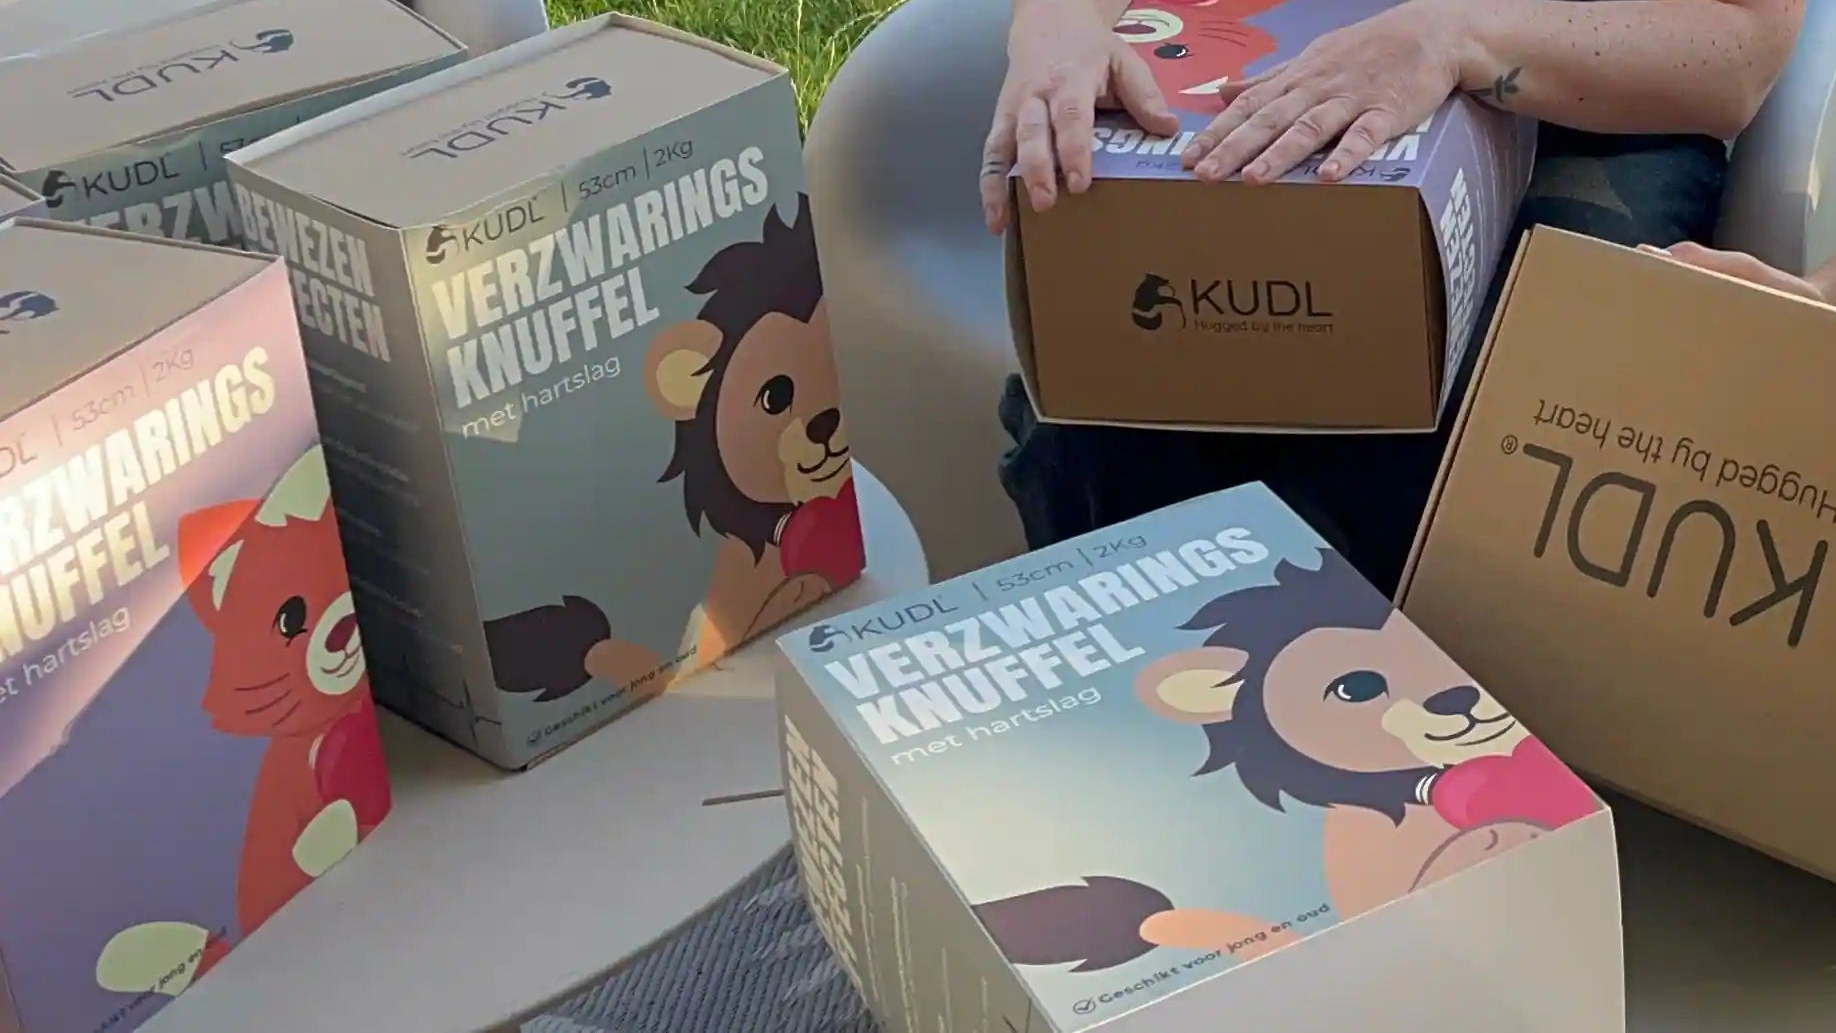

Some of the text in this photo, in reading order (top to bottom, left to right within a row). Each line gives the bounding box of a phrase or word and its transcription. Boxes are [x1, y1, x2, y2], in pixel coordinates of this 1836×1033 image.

[73, 50, 238, 101] KUDL
[409, 100, 566, 159] KUDL
[82, 155, 181, 199] KUDL
[463, 199, 545, 251] KUDL
[579, 166, 636, 200] 53cm
[236, 183, 374, 297] BEWEZEN
[431, 148, 768, 339] VERZWARINGS
[293, 269, 391, 363] ECTEN
[447, 267, 659, 409] KNUFFEL
[1190, 279, 1333, 317] KUDL
[0, 438, 37, 478] DL
[71, 386, 136, 431] 53cm
[461, 401, 514, 439] met
[521, 355, 621, 412] hartslag
[1533, 399, 1611, 450] heart
[0, 346, 275, 576] RZWARINGS
[1617, 426, 1661, 464] the
[1671, 436, 1712, 482] by
[0, 500, 169, 663] UFFEL
[825, 527, 1270, 700] VERZWARINGS
[852, 597, 958, 640] KUDL
[997, 559, 1074, 592] 53cm
[22, 607, 130, 686] hartslag
[856, 624, 1146, 745] KNUFFEL
[889, 687, 1102, 766] met hartslag
[1098, 903, 1331, 1003] Geschikt voor jong en oud
